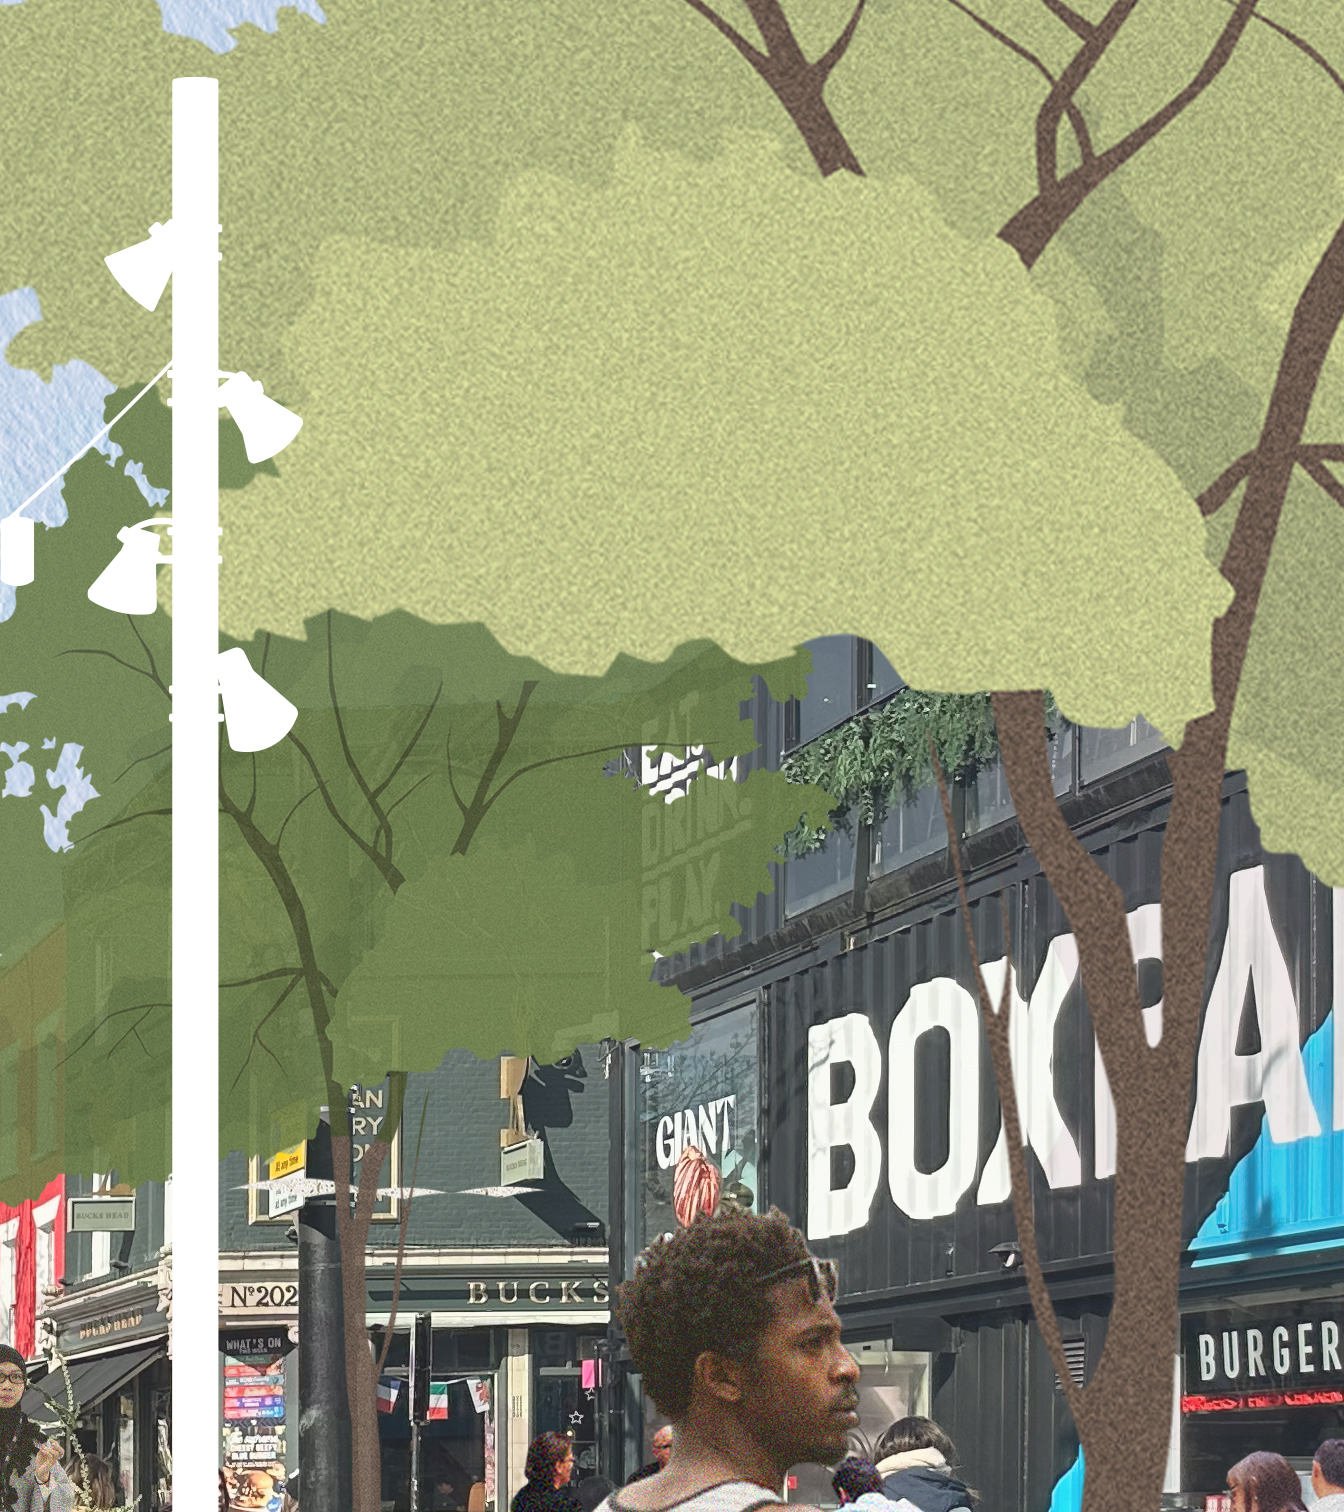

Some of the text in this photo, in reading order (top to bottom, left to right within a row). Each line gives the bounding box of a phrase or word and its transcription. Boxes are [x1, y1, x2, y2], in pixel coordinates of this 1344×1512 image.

[808, 865, 1344, 1240] BOXA
[656, 1094, 737, 1170] GIANT
[466, 1280, 610, 1304] BUCKS
[226, 1338, 282, 1350] WHAT'S ON
[1199, 1321, 1342, 1381] BURGER
